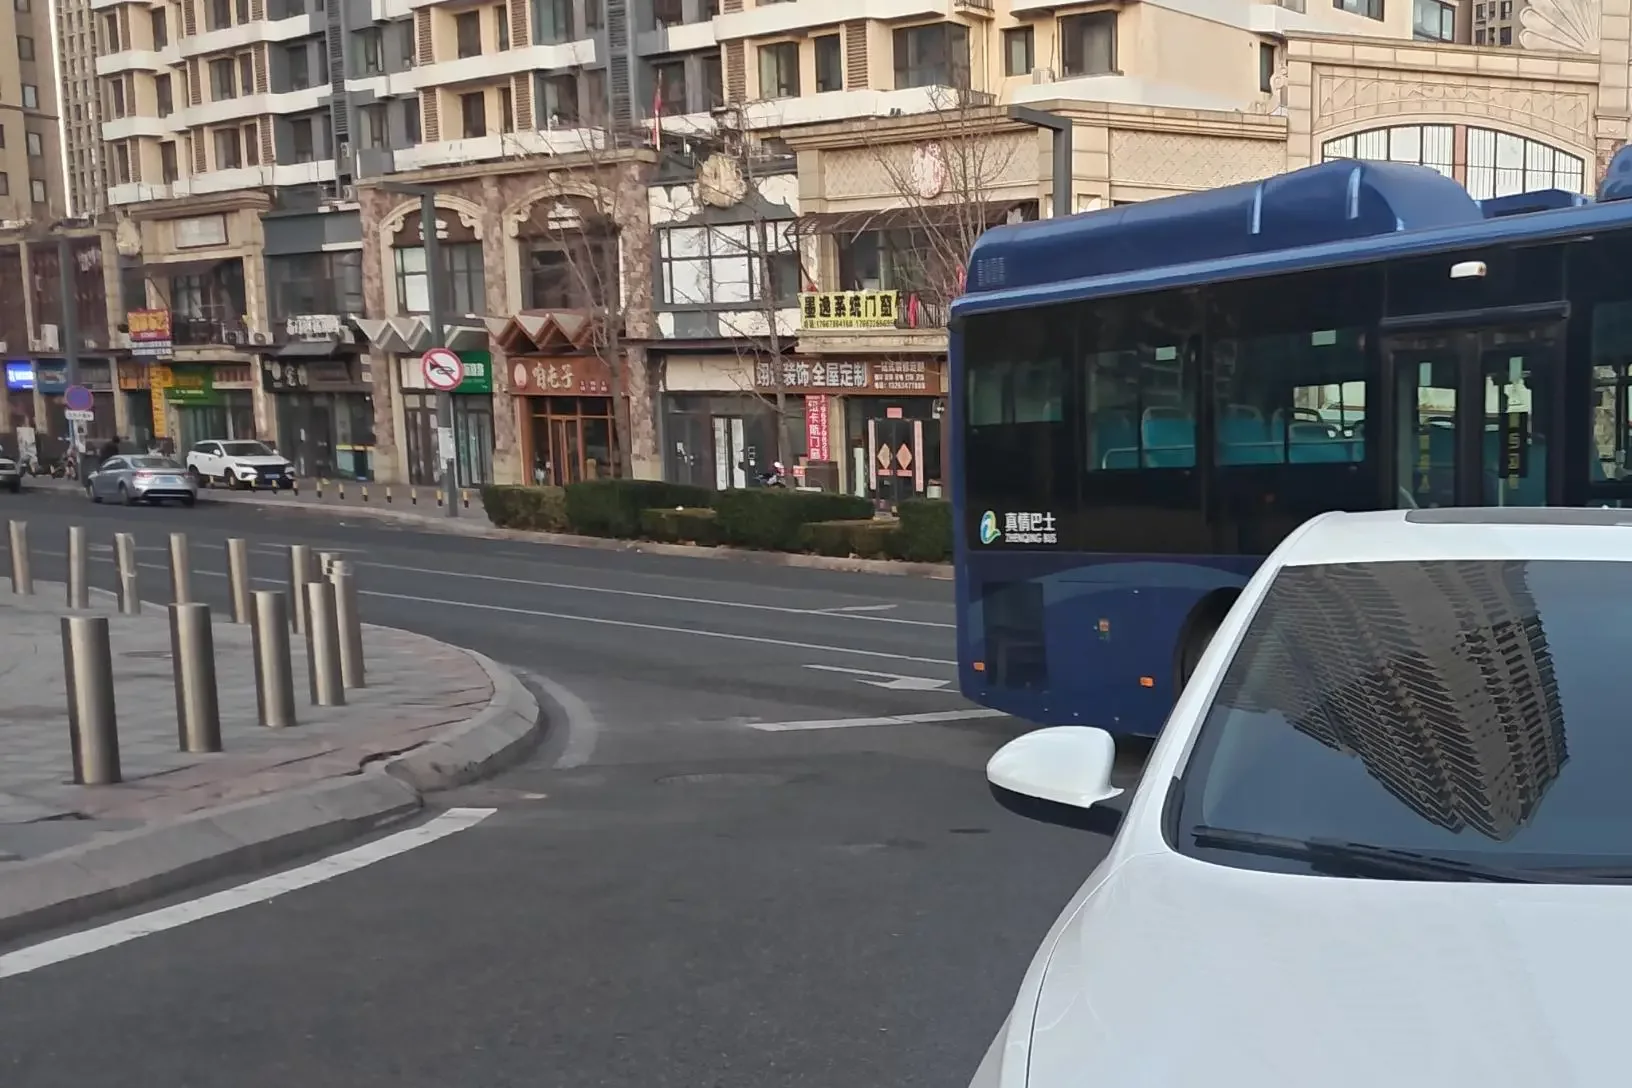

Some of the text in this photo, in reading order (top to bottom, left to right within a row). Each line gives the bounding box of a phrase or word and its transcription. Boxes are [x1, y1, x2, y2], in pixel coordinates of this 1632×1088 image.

[812, 361, 868, 388] 全屋定制
[1005, 512, 1056, 531] 真情巴士
